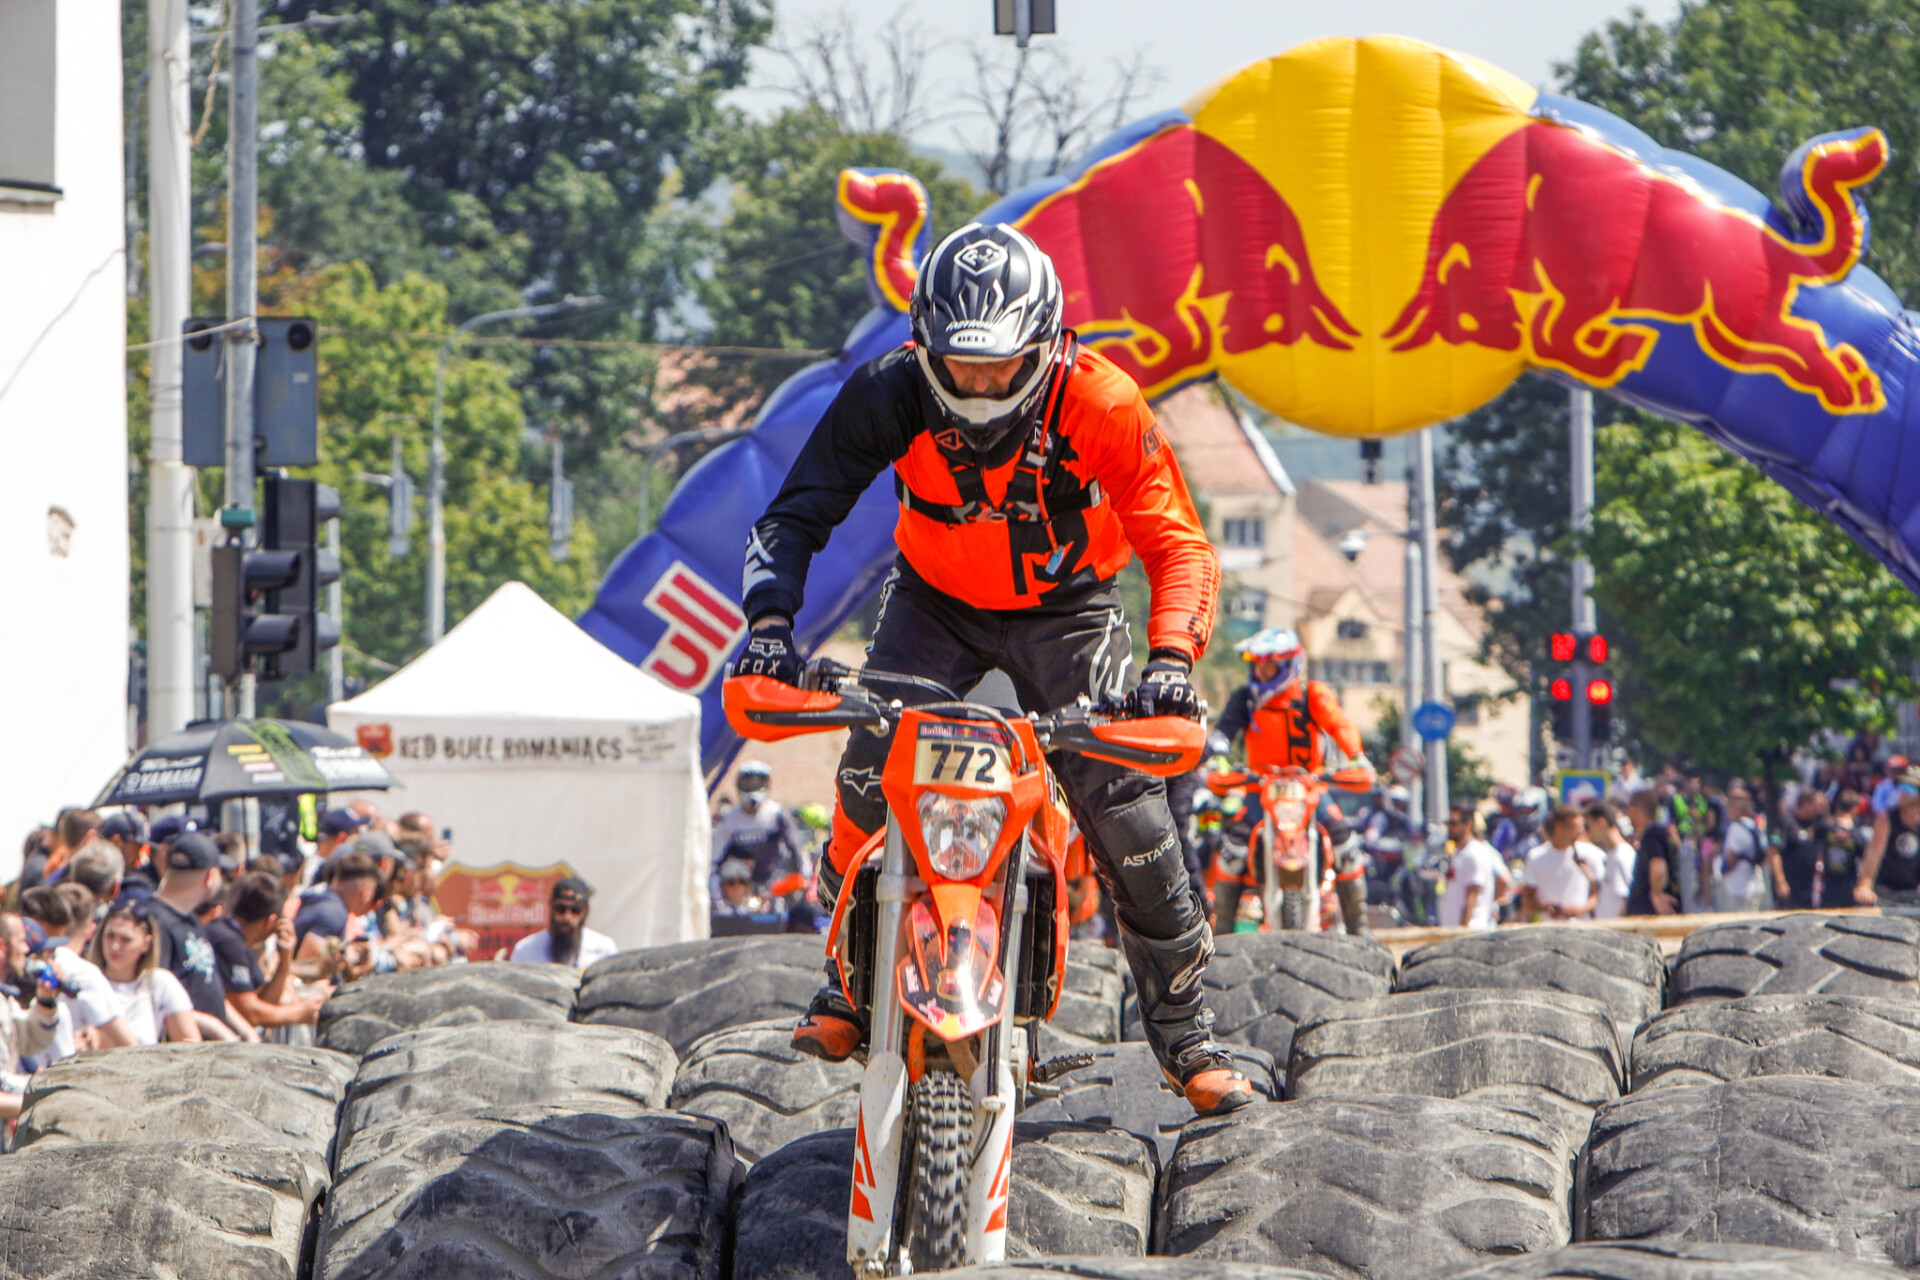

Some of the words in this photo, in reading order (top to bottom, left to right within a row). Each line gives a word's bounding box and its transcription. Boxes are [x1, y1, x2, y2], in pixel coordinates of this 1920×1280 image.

[956, 335, 987, 343] BELL
[739, 658, 781, 675] FOX
[1158, 684, 1195, 704] FOX
[398, 734, 437, 759] RED
[443, 735, 493, 761] BULL
[503, 736, 623, 761] ROMANIACS
[930, 743, 997, 784] 772
[1122, 832, 1175, 868] ASTARS
